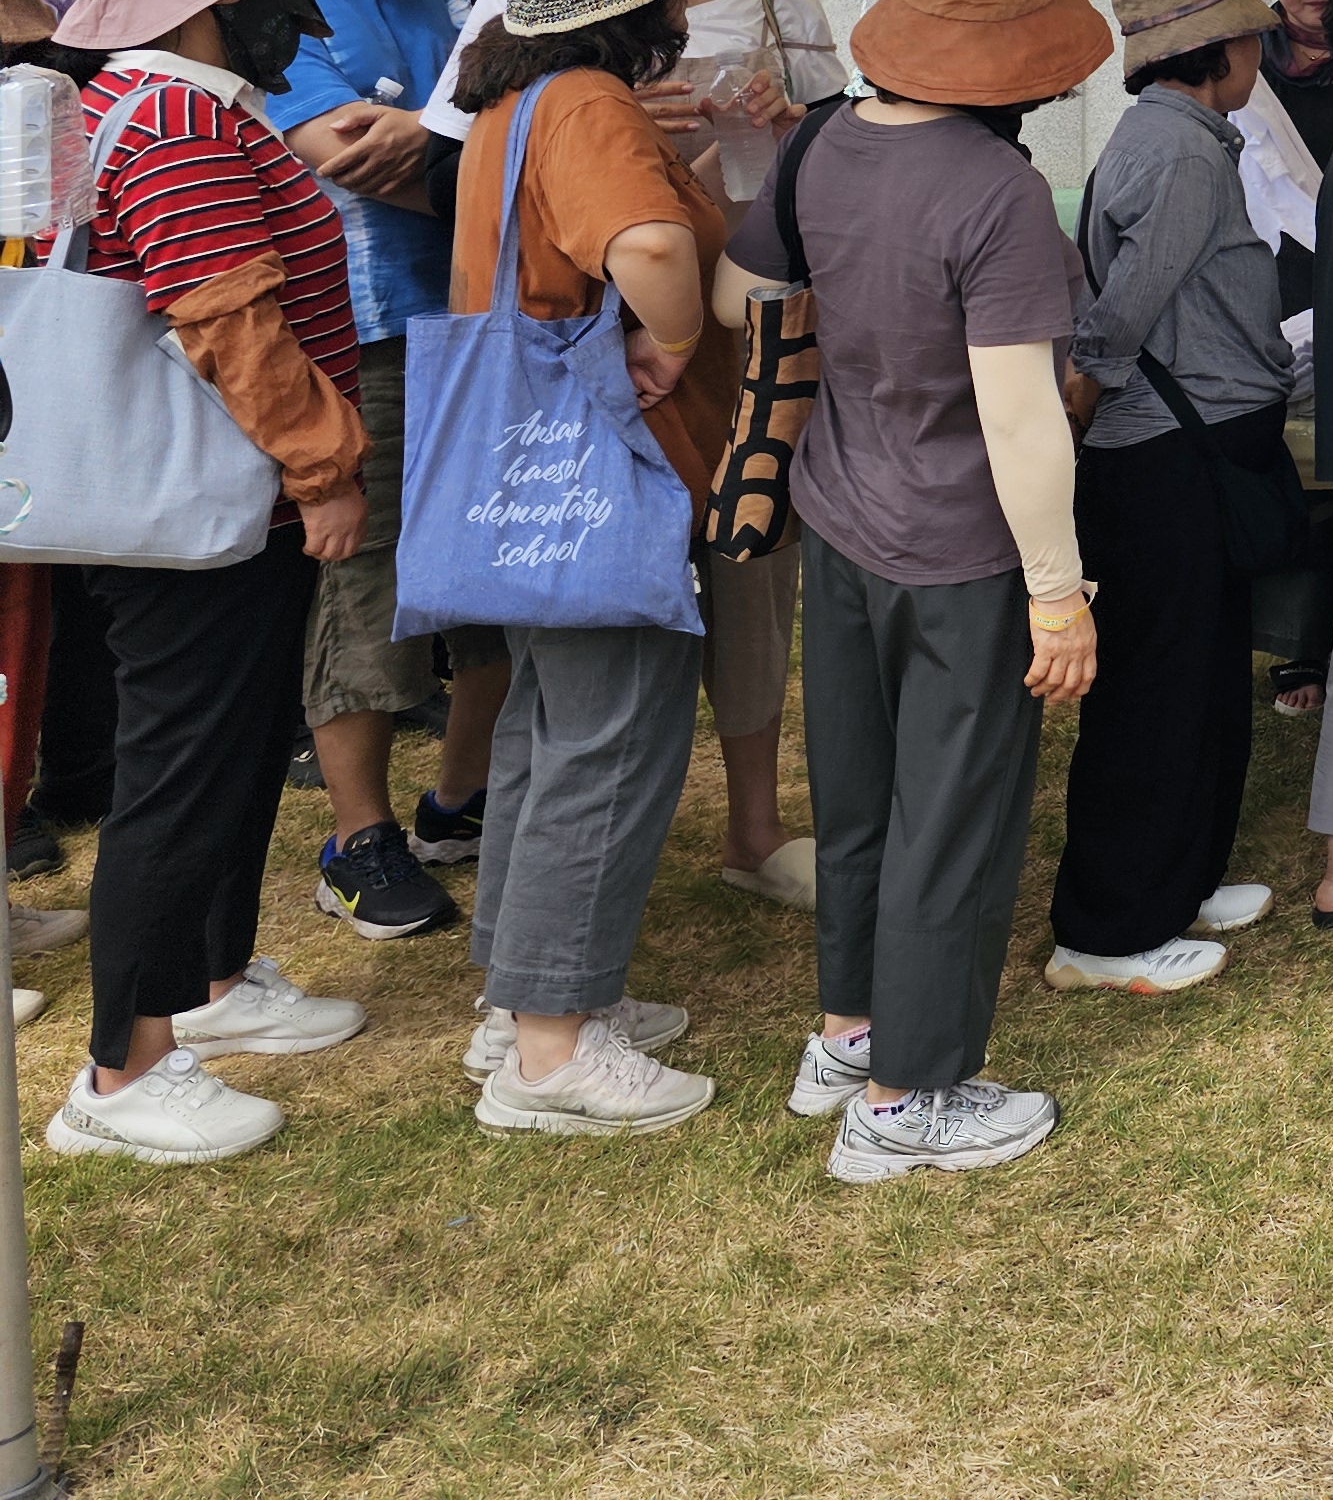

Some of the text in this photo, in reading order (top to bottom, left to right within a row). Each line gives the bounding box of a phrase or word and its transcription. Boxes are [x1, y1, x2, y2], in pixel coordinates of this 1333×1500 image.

[504, 444, 595, 487] haesol
[467, 484, 613, 528] elementary
[491, 526, 591, 568] school
